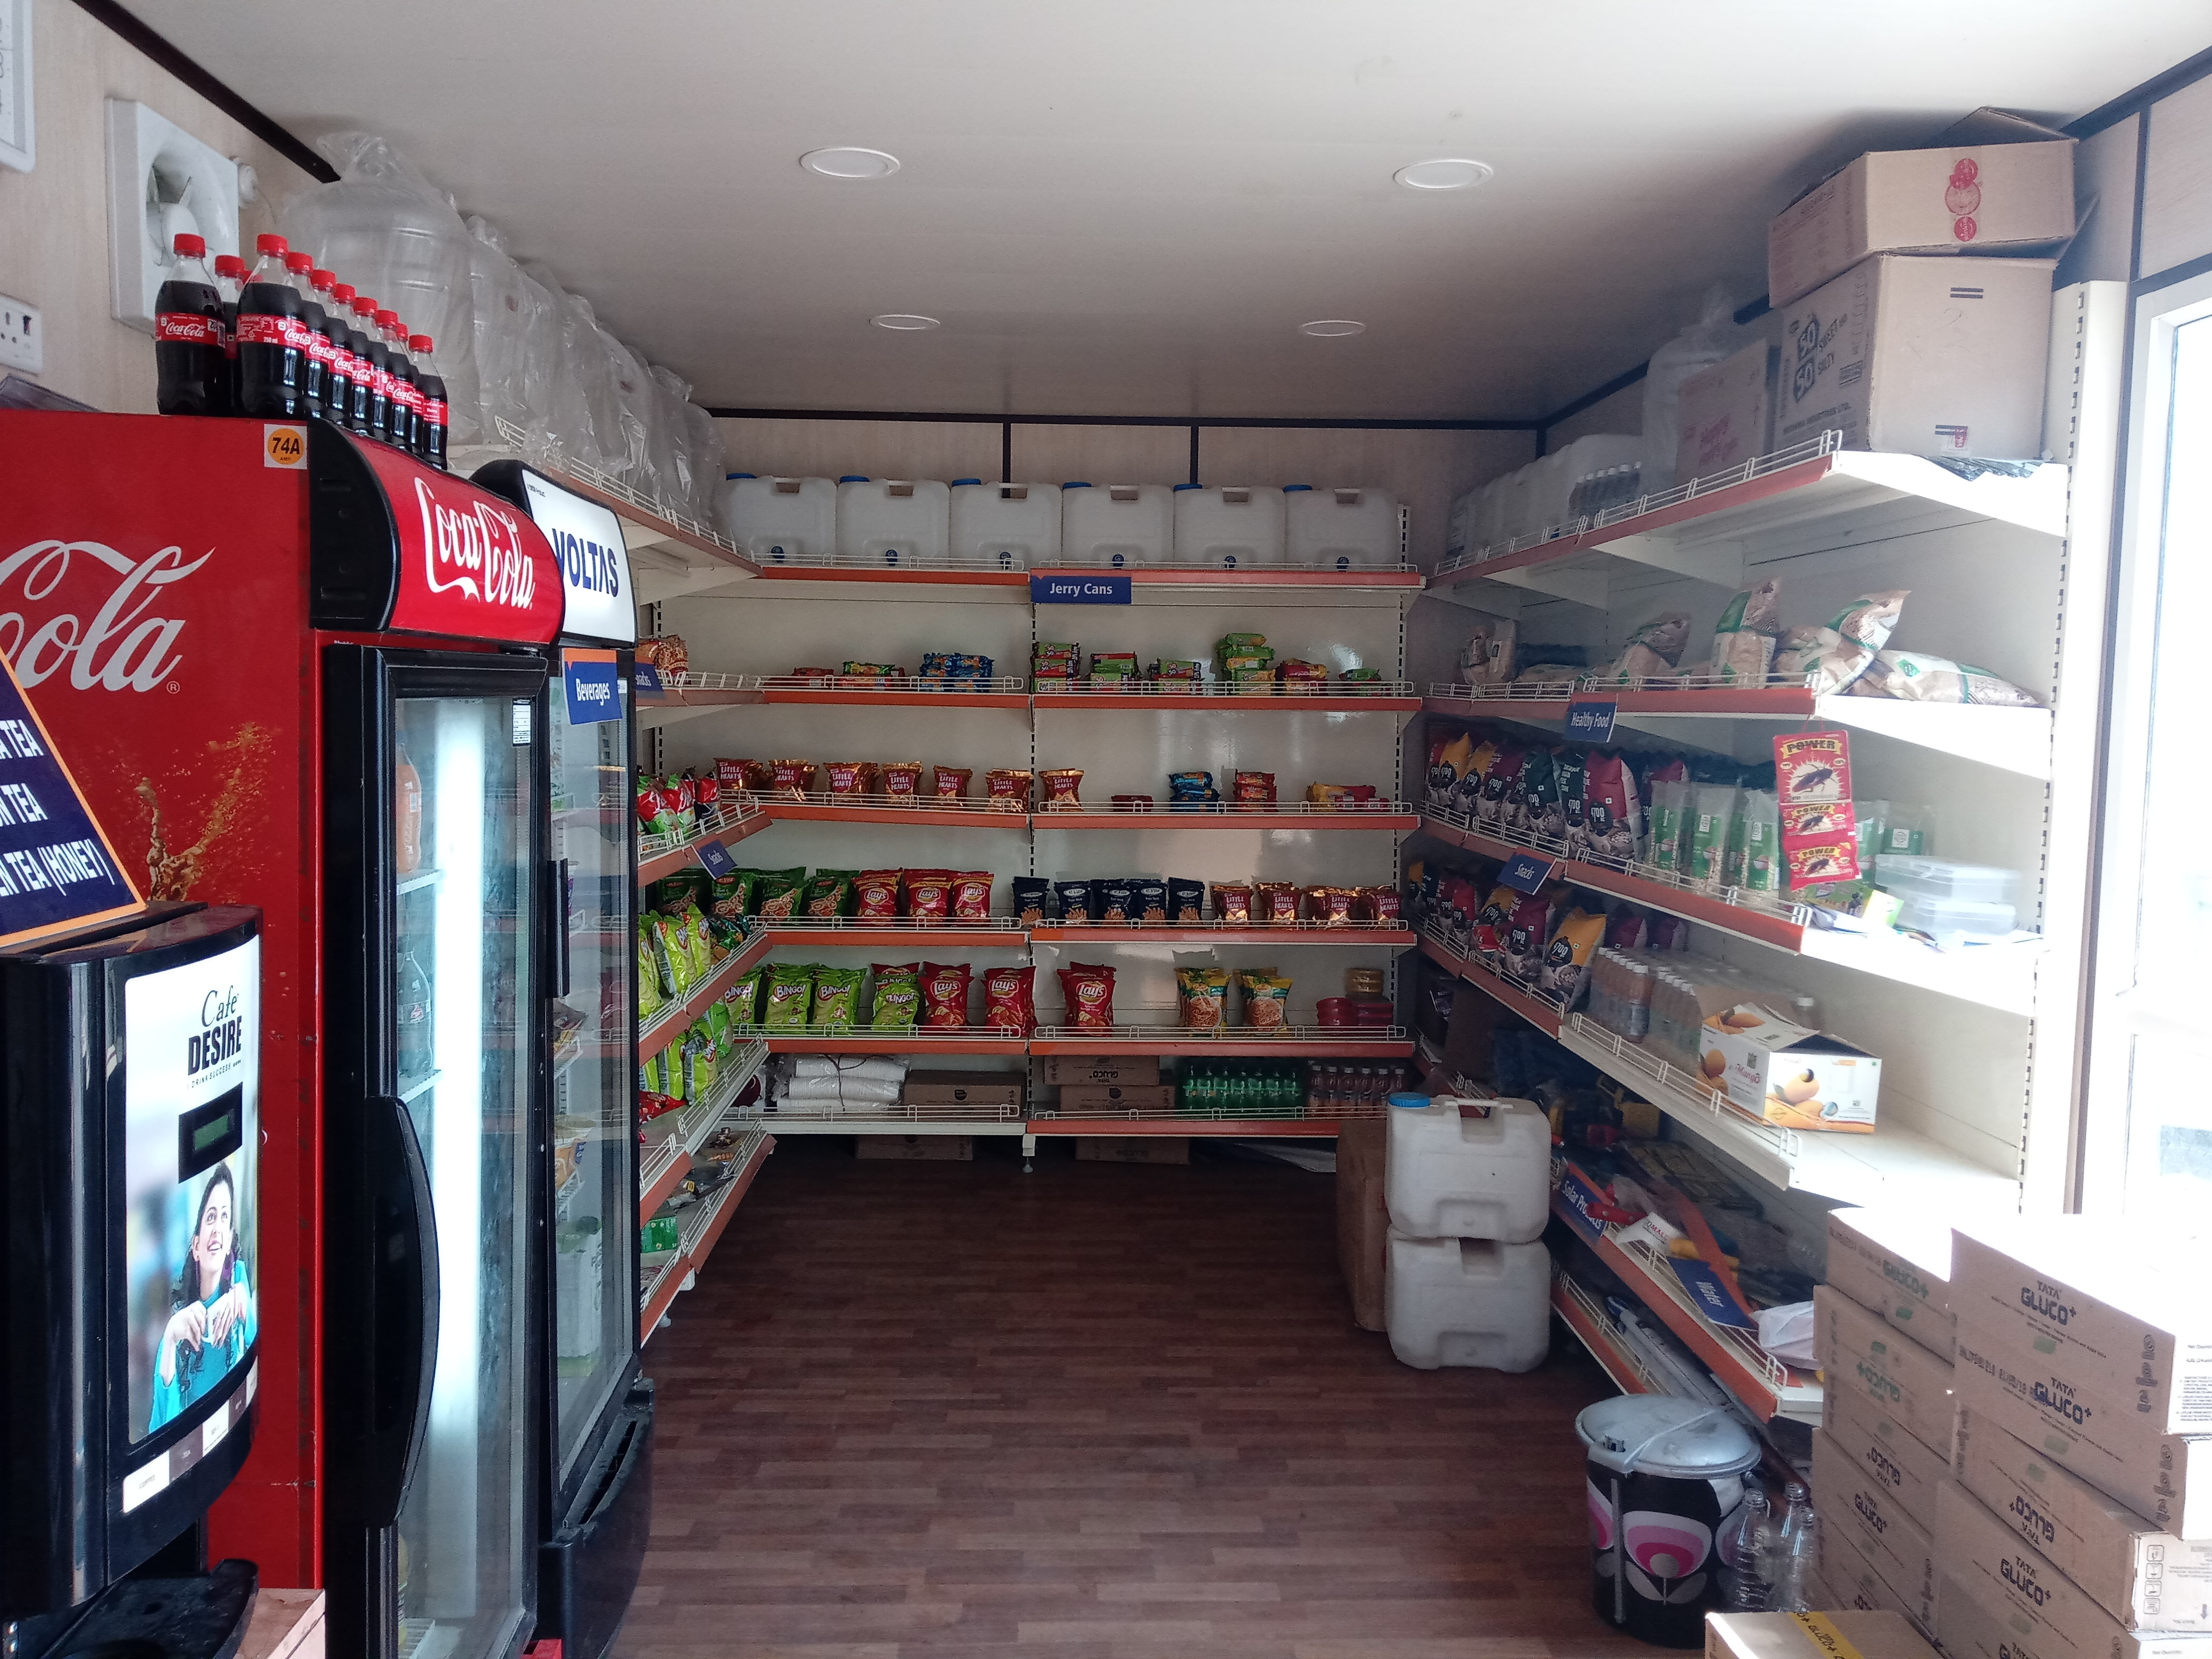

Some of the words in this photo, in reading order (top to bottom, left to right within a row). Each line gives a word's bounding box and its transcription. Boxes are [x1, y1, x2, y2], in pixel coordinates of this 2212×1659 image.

[272, 437, 300, 455] 74A
[551, 527, 619, 598] VOLTAS
[1050, 582, 1081, 596] Jerry
[1084, 583, 1113, 594] Cans
[575, 678, 610, 706] Beverages
[1571, 711, 1595, 731] Healthy
[1594, 712, 1611, 728] Food
[1786, 739, 1836, 753] POWER
[1, 782, 49, 824] TEA
[1795, 805, 1831, 815] POWER
[1802, 847, 1836, 858] POWER
[3, 850, 52, 892] TEA
[1514, 864, 1535, 880] Snacks
[776, 984, 806, 997] BINGO!
[202, 985, 238, 1027] Cafe
[187, 1015, 242, 1076] DESIRE
[1562, 1179, 1579, 1204] Solar
[1696, 1281, 1724, 1308] Water
[2037, 1280, 2060, 1300] TATA
[2050, 1377, 2076, 1399] TATA
